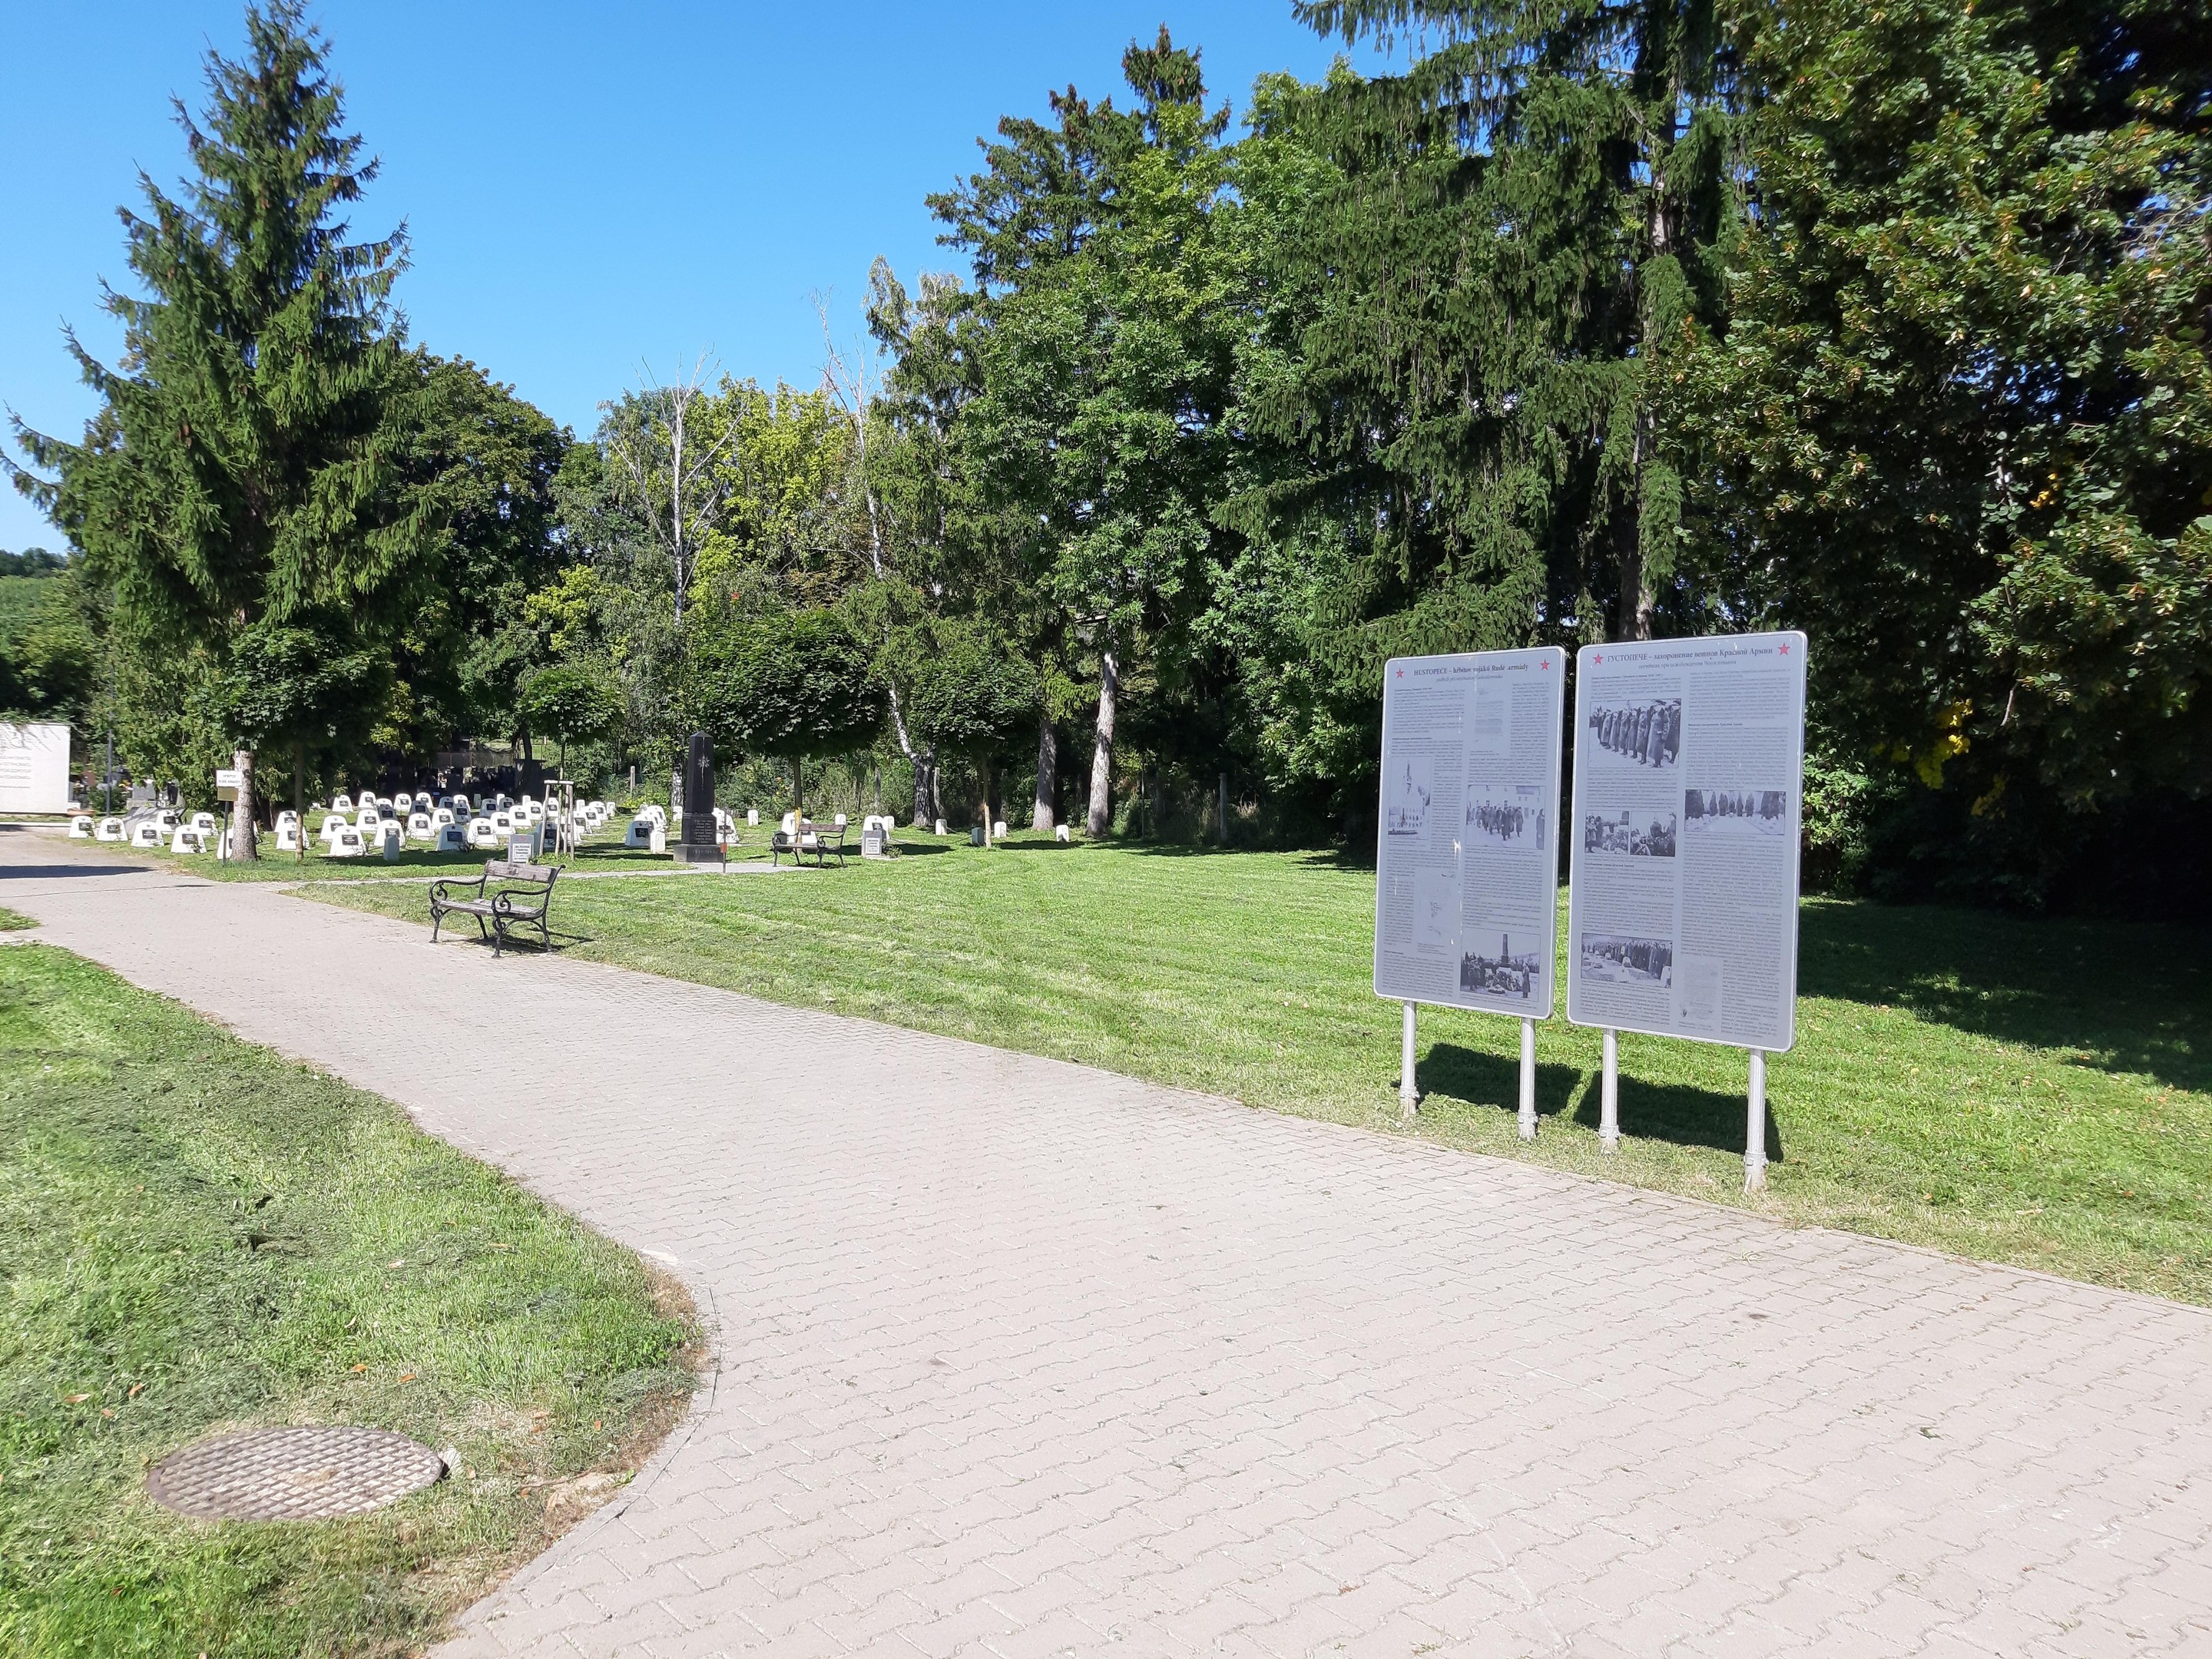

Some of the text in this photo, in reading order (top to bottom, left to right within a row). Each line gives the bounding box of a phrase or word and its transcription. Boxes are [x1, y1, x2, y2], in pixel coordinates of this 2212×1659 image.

[1608, 654, 1647, 662] ГУСТОПЕЧЕ
[1720, 649, 1747, 657] Красной
[1414, 667, 1447, 676] HUSTOPEČE
[1508, 663, 1528, 671] armády
